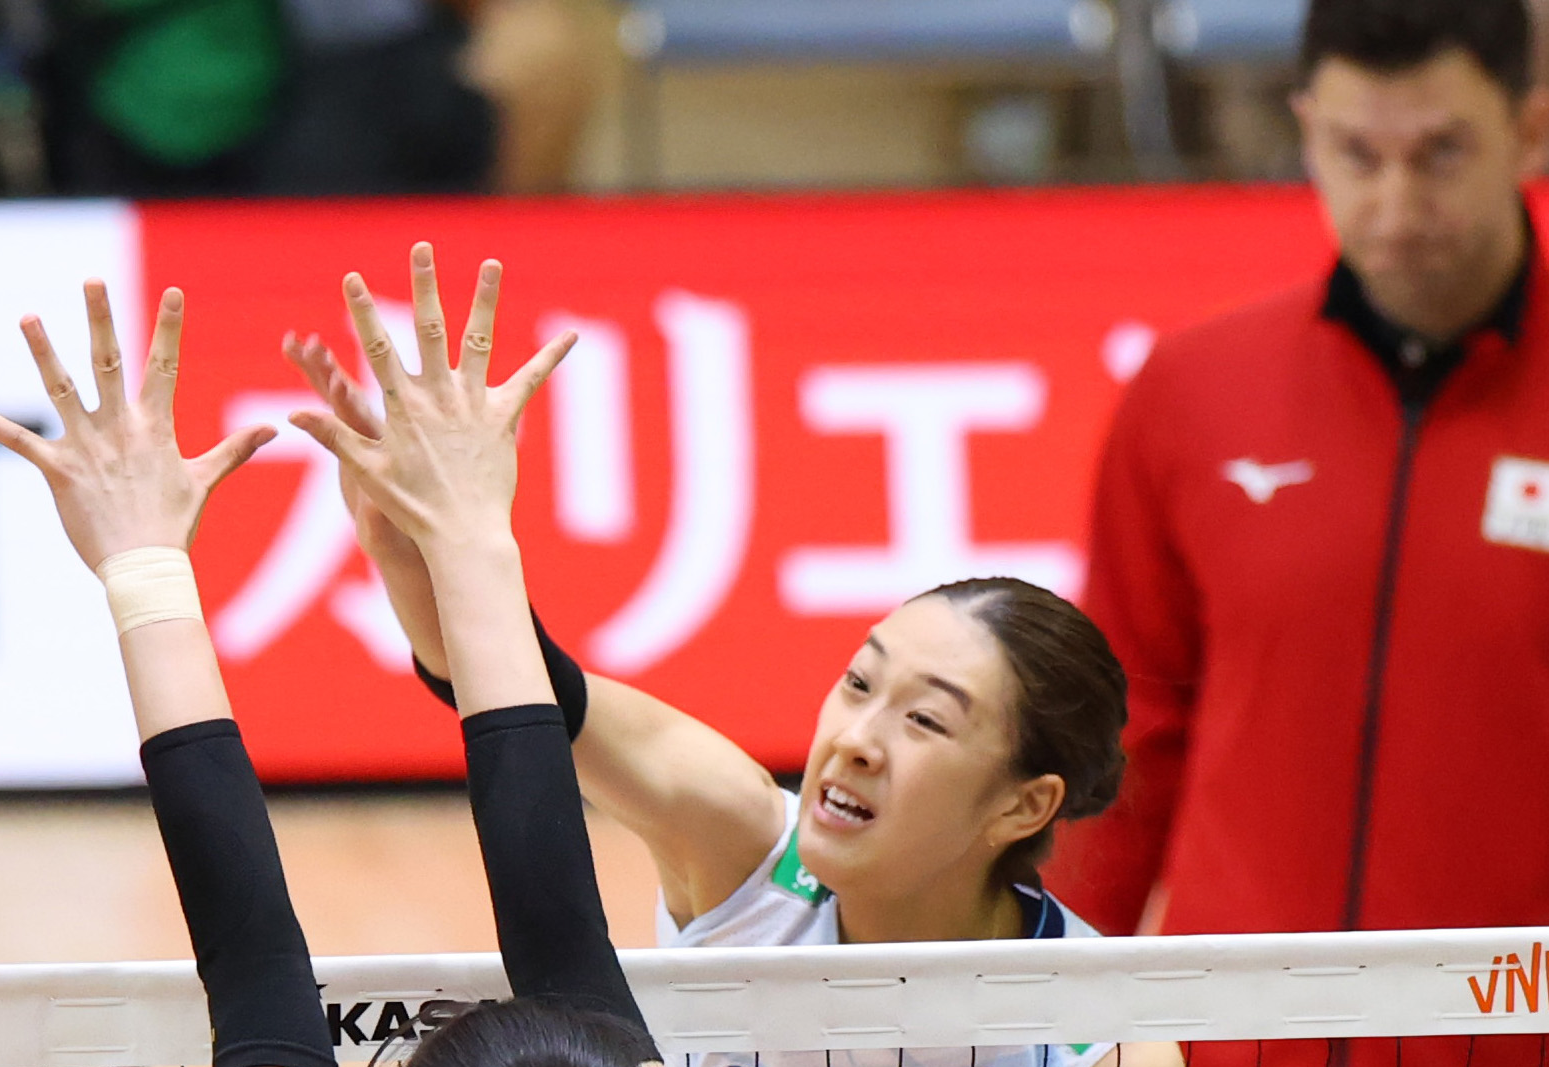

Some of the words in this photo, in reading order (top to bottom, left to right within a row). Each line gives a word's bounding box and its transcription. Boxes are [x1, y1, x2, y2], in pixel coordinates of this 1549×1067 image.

[210, 292, 1153, 674] オリエ
[1467, 942, 1549, 1013] VN
